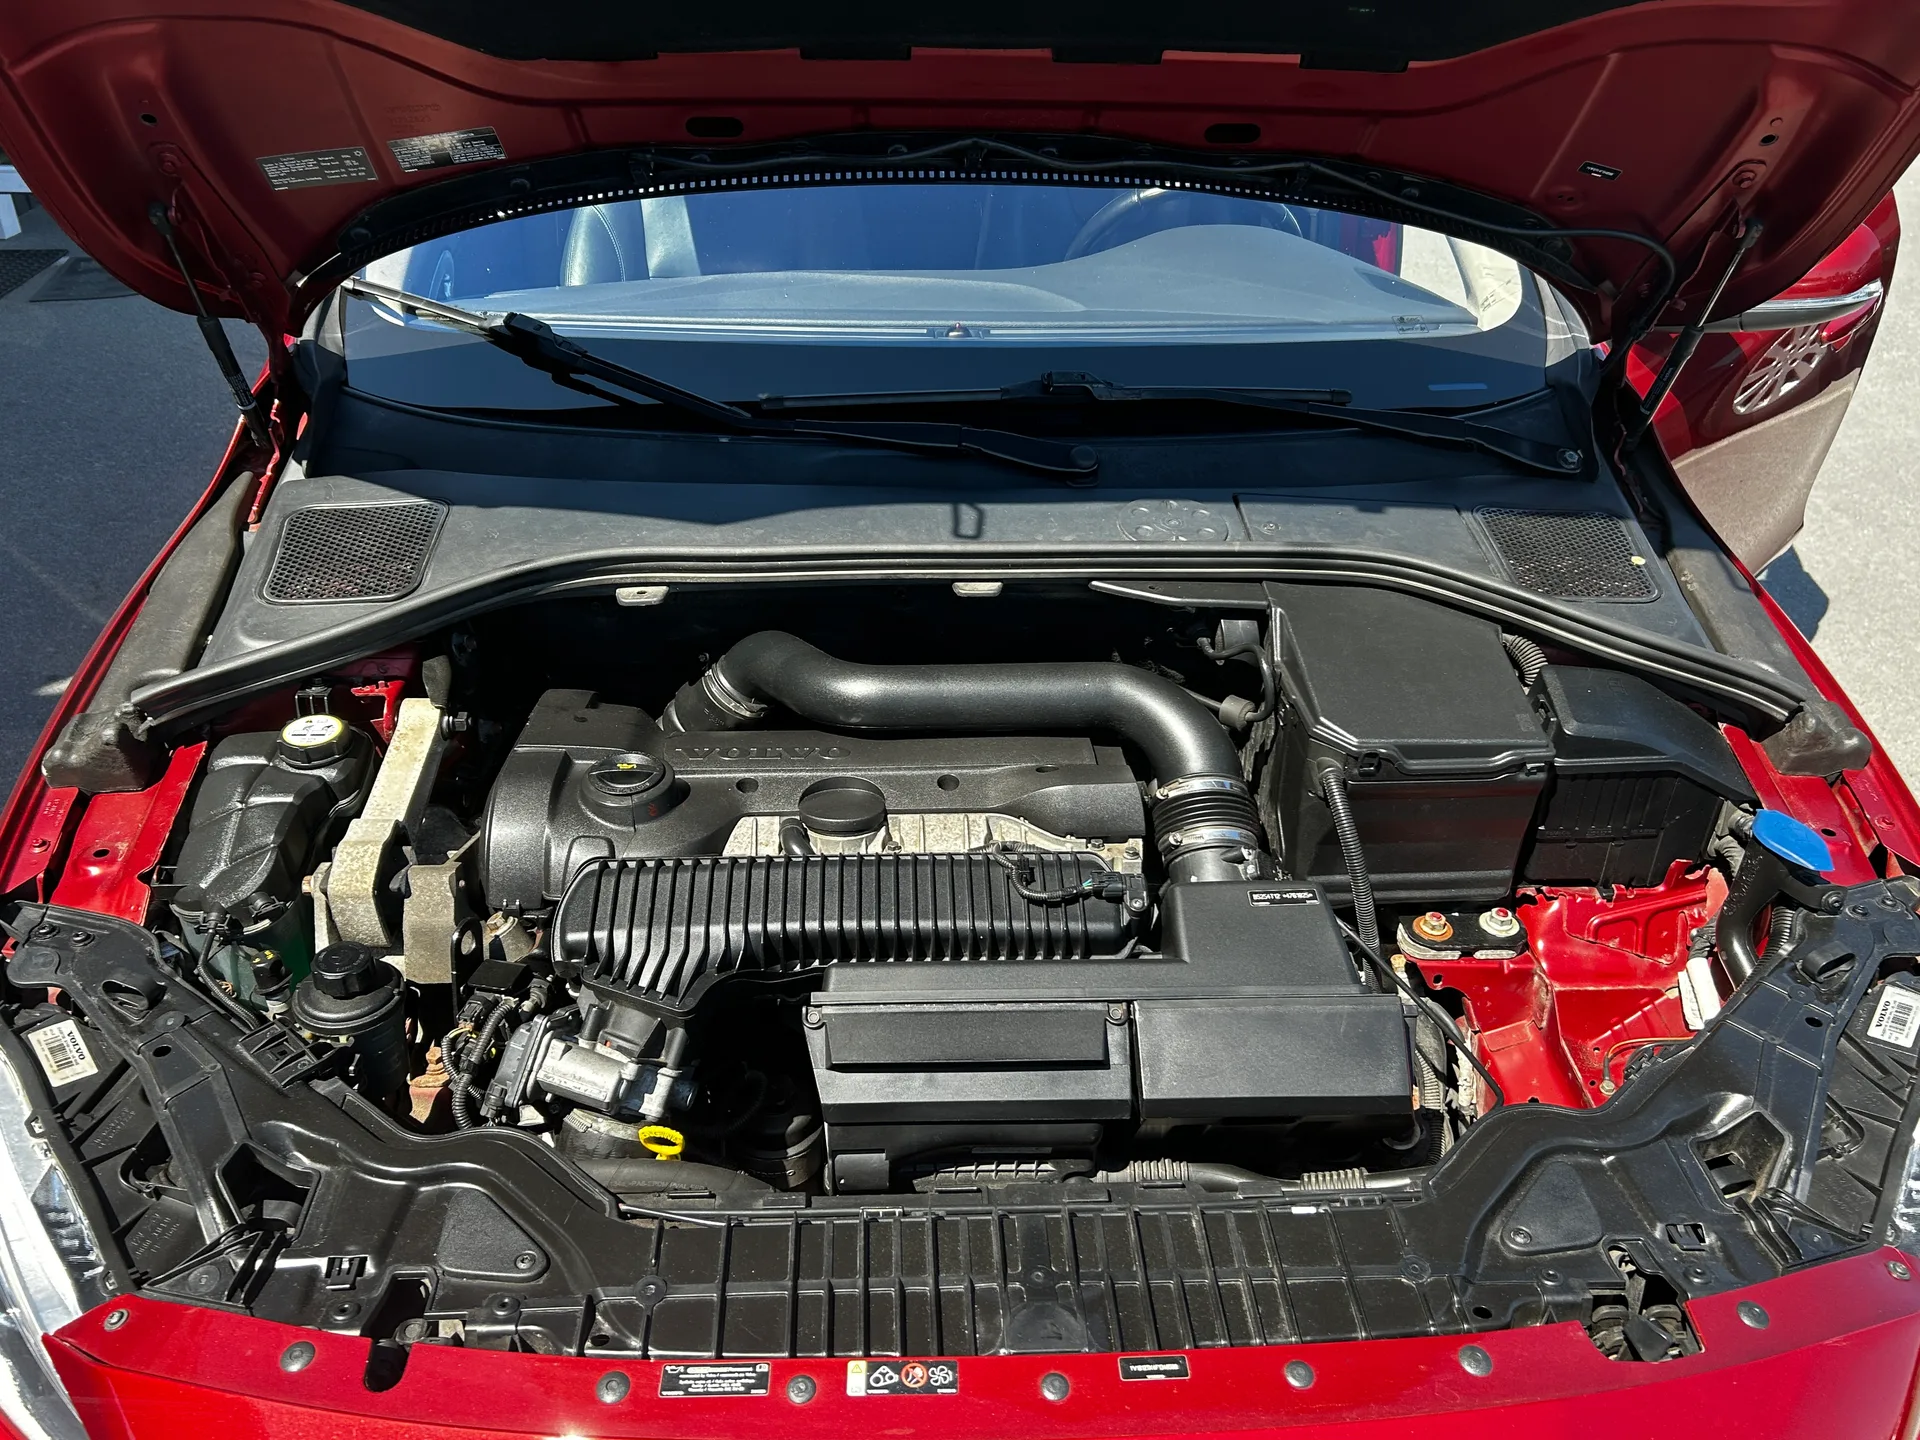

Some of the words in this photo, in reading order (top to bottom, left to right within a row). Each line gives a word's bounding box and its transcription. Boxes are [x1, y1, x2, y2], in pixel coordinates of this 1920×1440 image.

[675, 746, 851, 761] VOLVO
[1875, 1000, 1891, 1028] VOLVO
[67, 1029, 86, 1061] VOLVO
